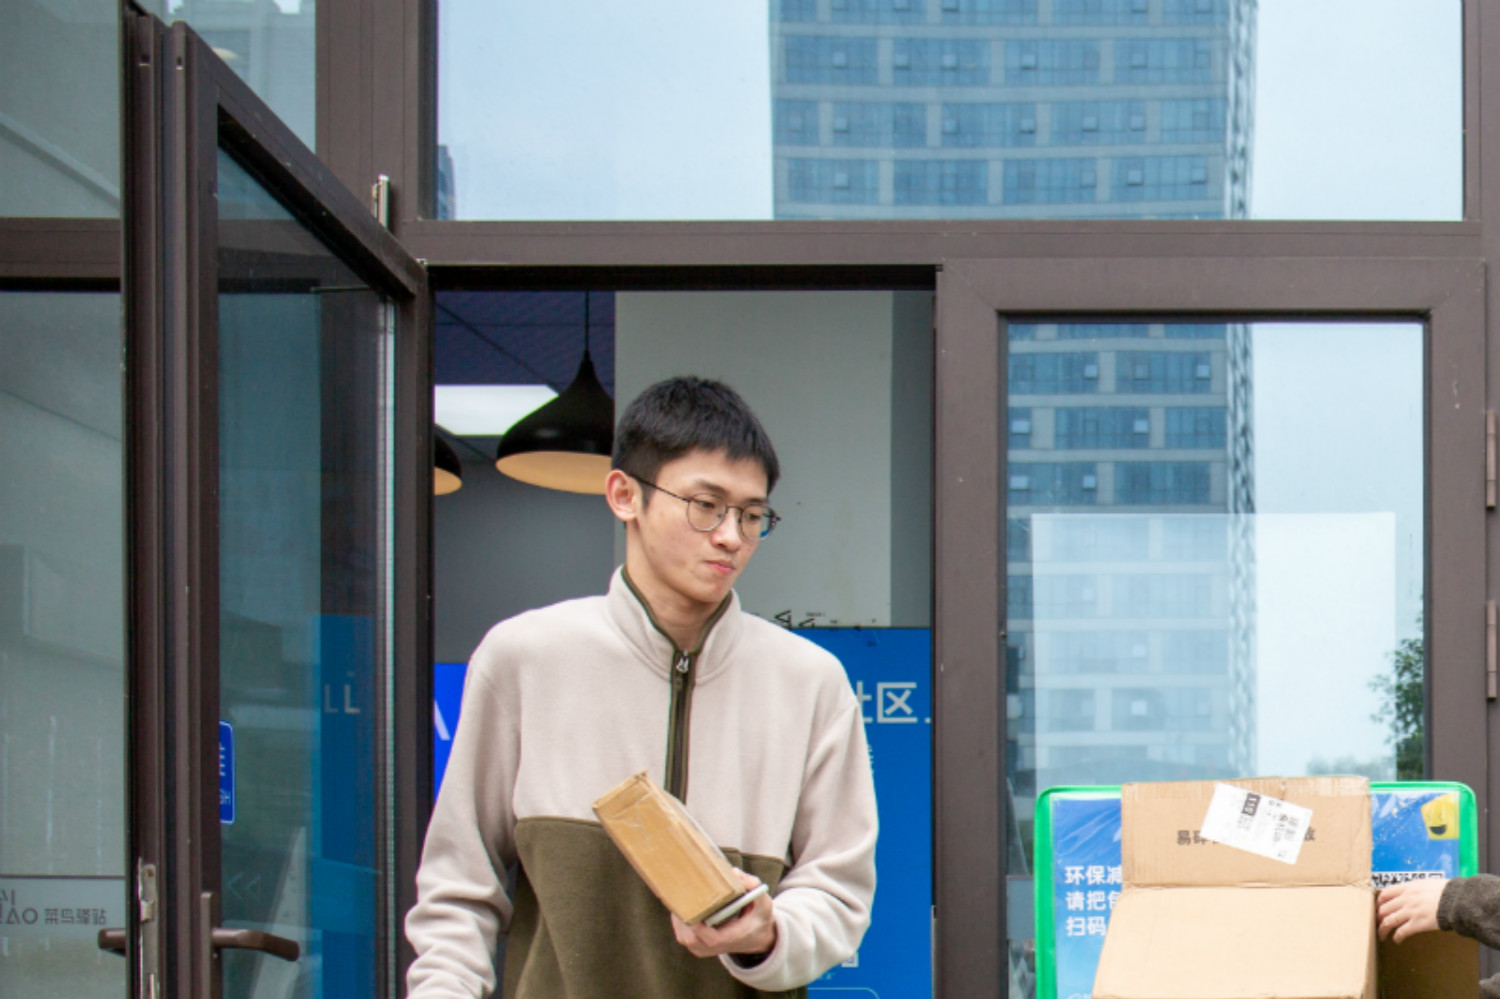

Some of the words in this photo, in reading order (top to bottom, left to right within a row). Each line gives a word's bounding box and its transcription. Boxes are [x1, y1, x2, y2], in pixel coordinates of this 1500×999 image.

[1064, 865, 1122, 886] 环保减
[44, 908, 107, 925] 菜鸟驿站
[1066, 916, 1108, 936] 扫码
